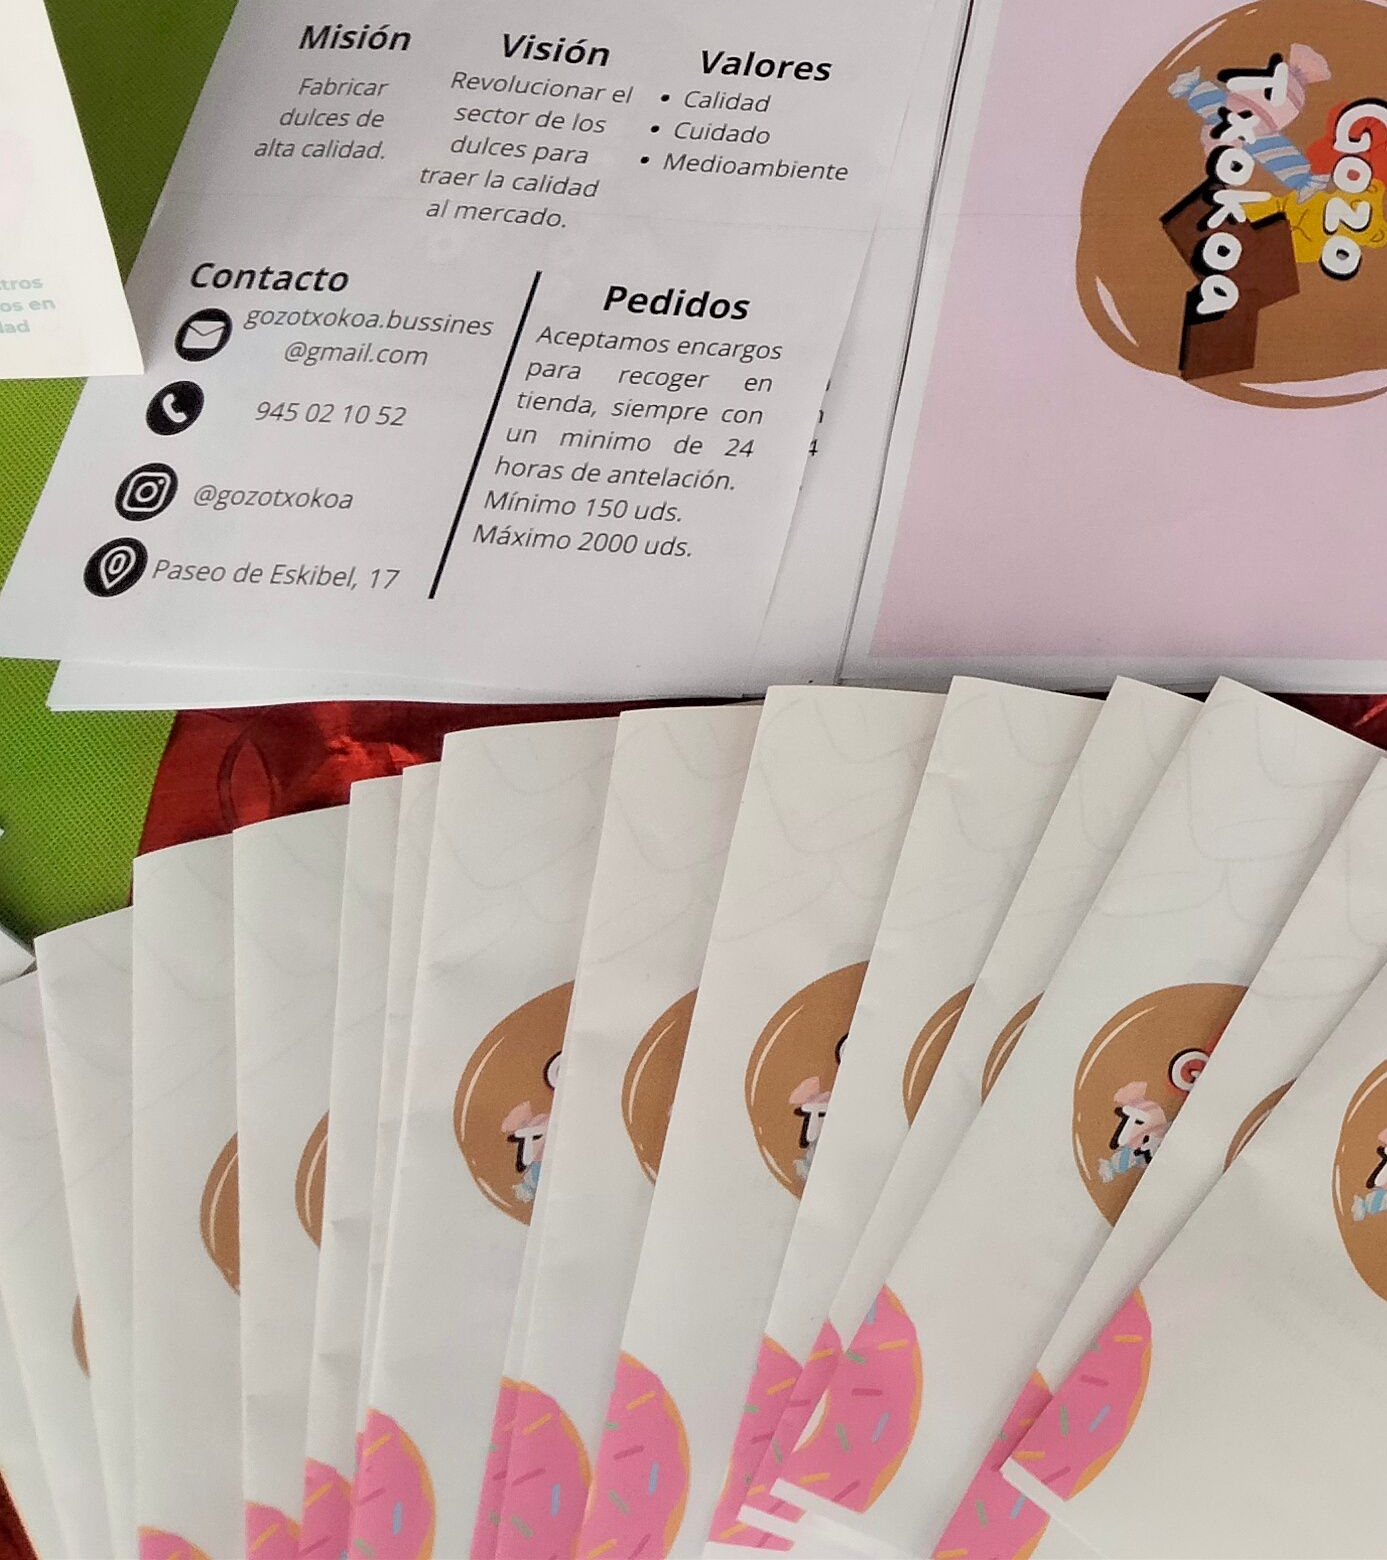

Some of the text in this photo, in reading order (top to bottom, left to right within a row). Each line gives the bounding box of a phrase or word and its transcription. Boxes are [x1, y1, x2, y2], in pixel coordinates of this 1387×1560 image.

[298, 24, 412, 52] Misión
[500, 34, 611, 68] Visión
[700, 50, 833, 82] Valores
[298, 76, 389, 98] Fabricar
[450, 72, 634, 104] Revolucionar el
[684, 90, 771, 113] Calidad
[279, 107, 385, 128] dulces de
[454, 103, 606, 134] sector de los
[673, 122, 771, 145] Cuidado
[254, 139, 386, 161] alta calidad.
[450, 135, 589, 166] dulces para
[419, 166, 600, 198] traer la calidad
[662, 152, 850, 182] Medioambiente
[425, 198, 567, 229] al mercado.
[0, 278, 43, 290] tros
[190, 262, 349, 292] Contacto
[0, 299, 56, 313] os en
[602, 285, 750, 320] Pedidos
[243, 307, 495, 336] gozotxokoa.bussines
[284, 341, 428, 366] @gmail.com
[535, 326, 783, 363] Aceptamos encargos
[525, 361, 773, 392] para recoger en
[254, 401, 407, 426] 945 02 10 52
[516, 391, 764, 425] tienda, siempre con
[506, 427, 754, 458] un minimo de 24
[494, 455, 735, 491] horas de antelación.
[193, 484, 354, 510] @gozotxokoa
[483, 490, 682, 522] Mínimo 150 uds.
[472, 523, 692, 557] Máximo 2000 uds.
[152, 559, 400, 590] Paseo de Eskibel, 17
